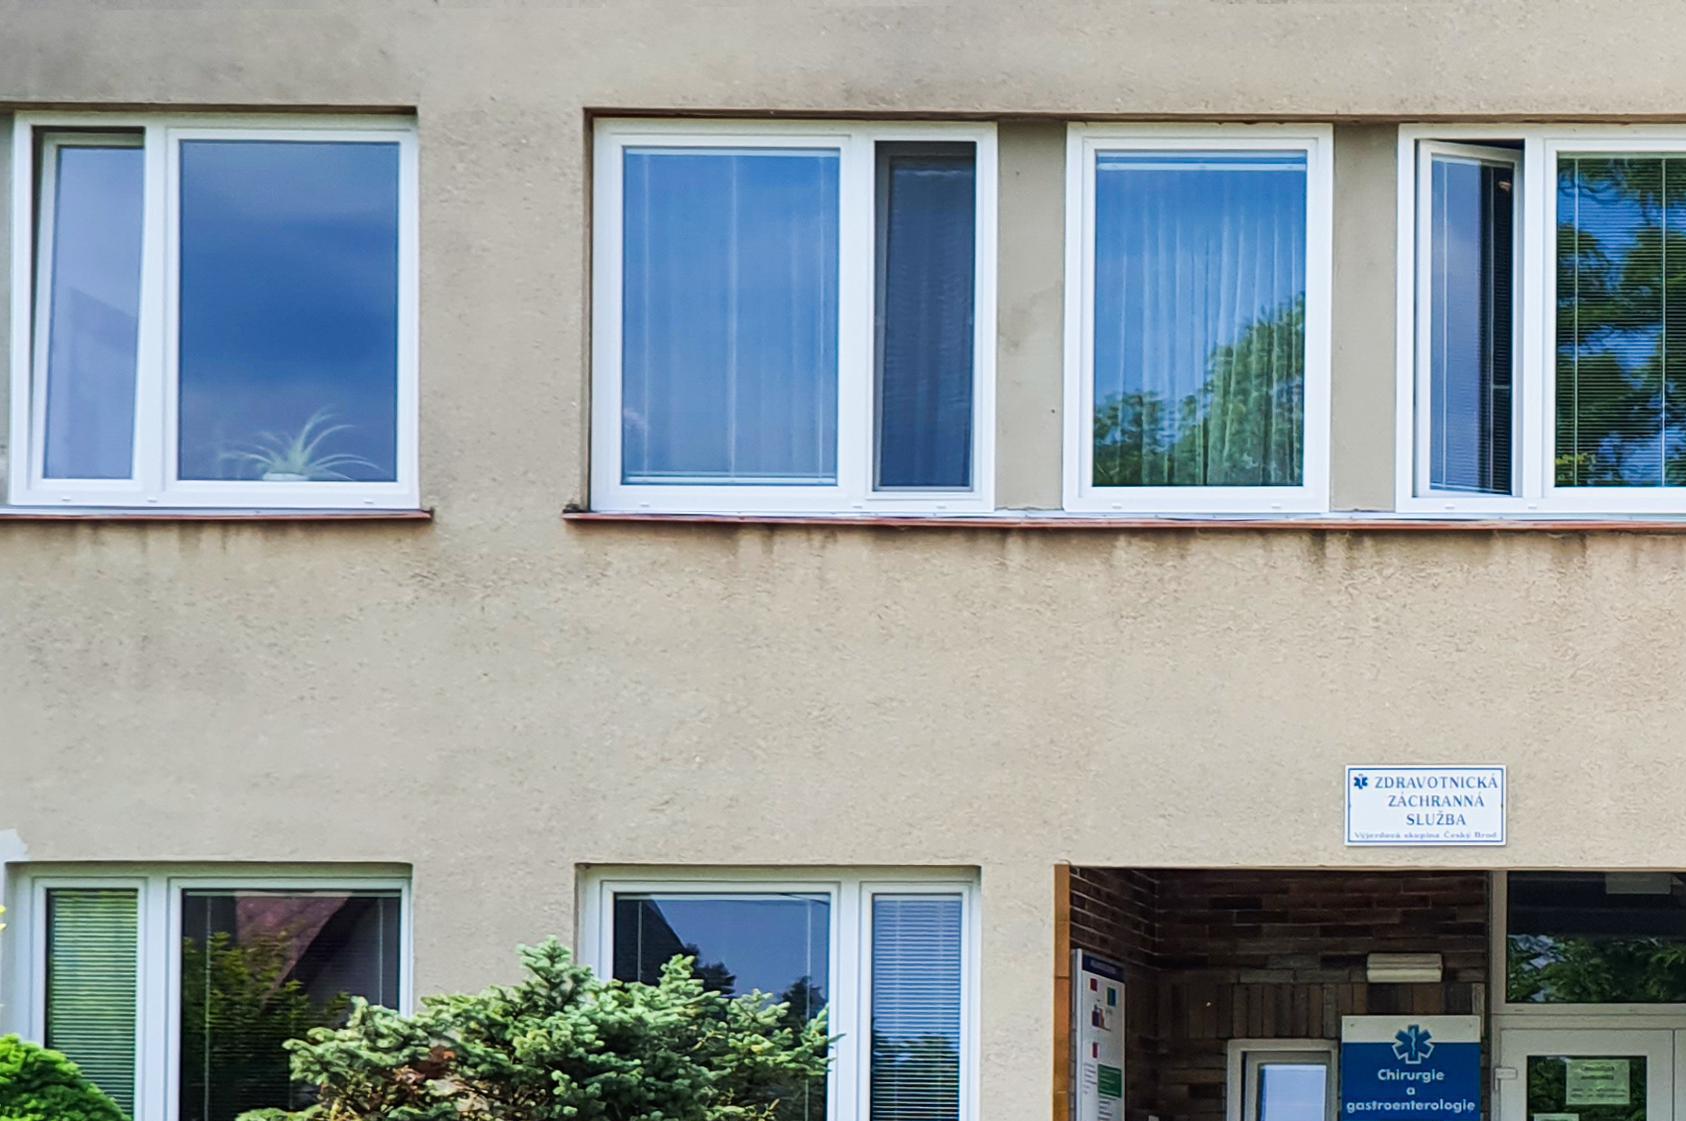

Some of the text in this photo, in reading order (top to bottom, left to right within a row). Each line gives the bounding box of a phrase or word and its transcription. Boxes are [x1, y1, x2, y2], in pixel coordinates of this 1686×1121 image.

[1374, 773, 1498, 789] ZDRAVOTNICKÁ
[1388, 792, 1485, 807] ZÁCHRANNÁ
[1406, 811, 1467, 826] SLUŽBA
[1474, 831, 1497, 839] Brod
[1377, 1069, 1445, 1083] Chirurgie
[1406, 1087, 1416, 1095] a
[1346, 1099, 1476, 1114] gastroenterologie
